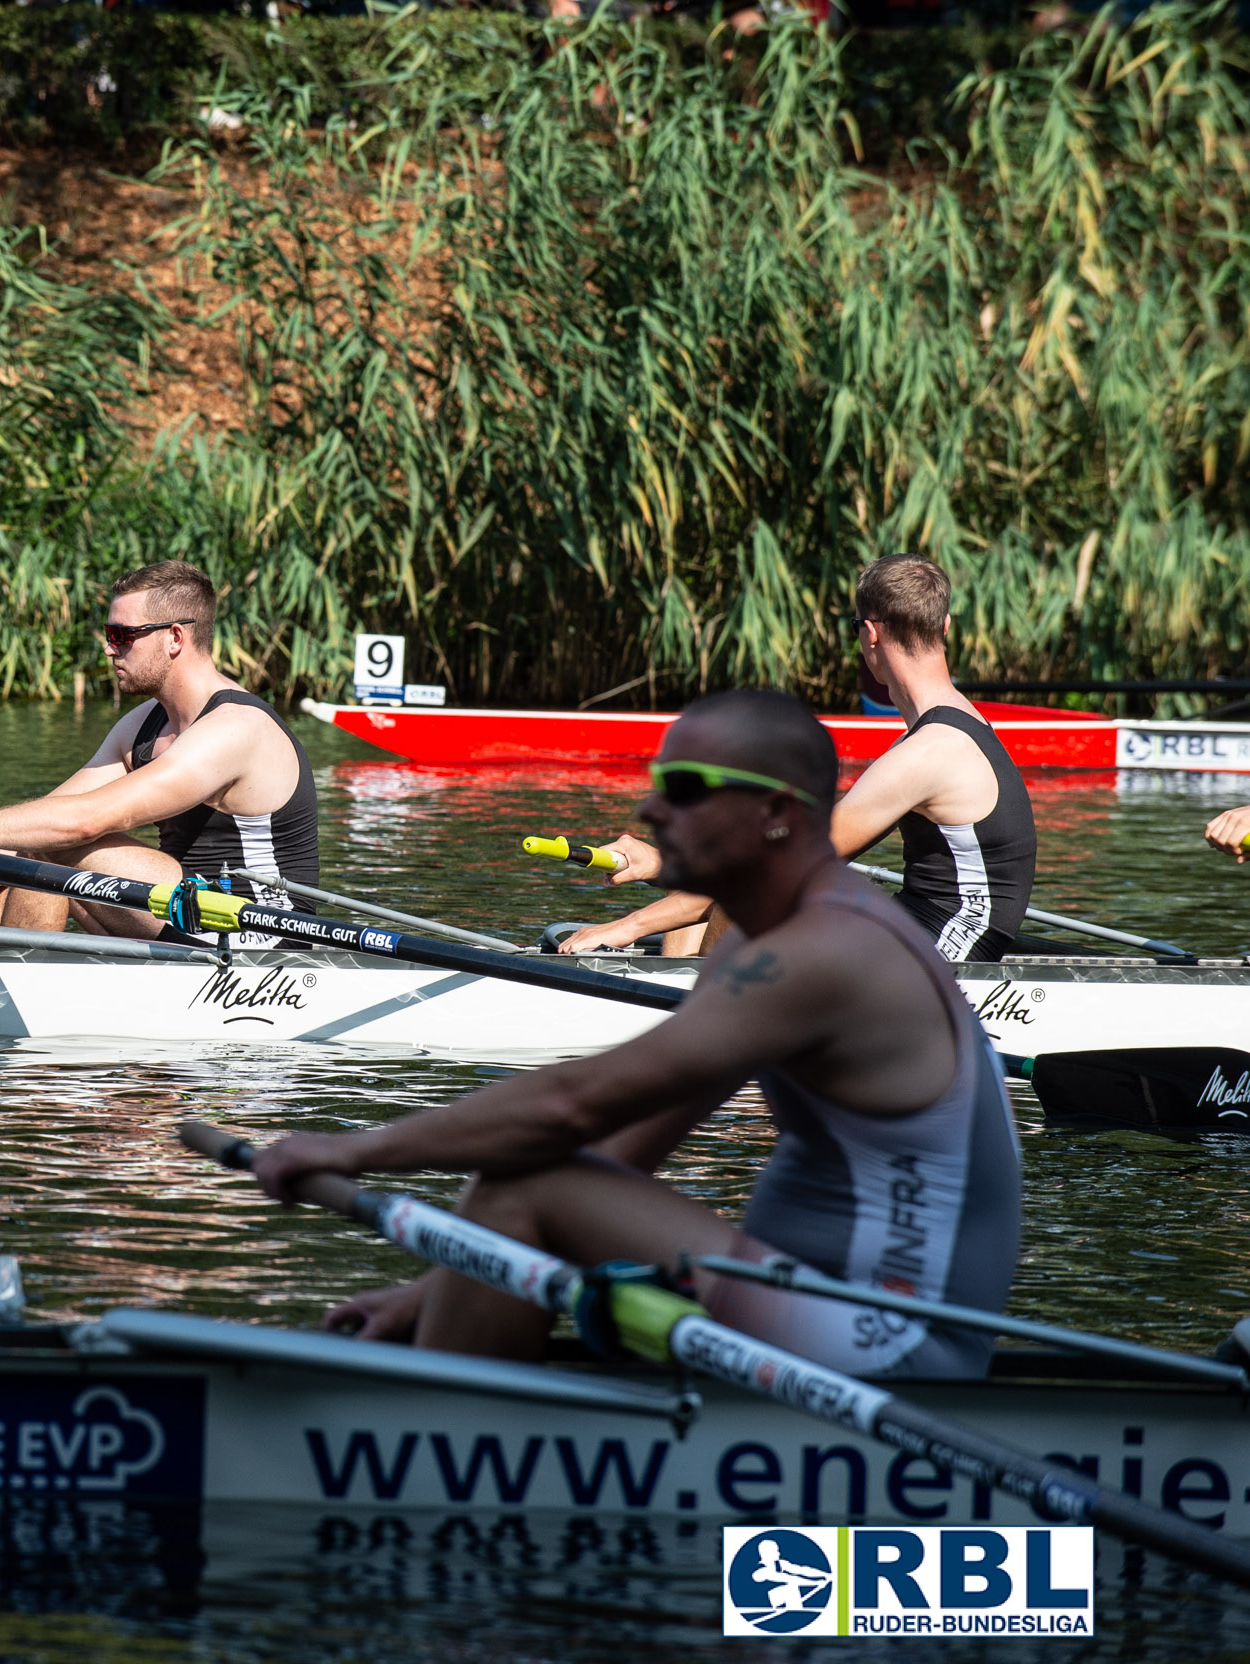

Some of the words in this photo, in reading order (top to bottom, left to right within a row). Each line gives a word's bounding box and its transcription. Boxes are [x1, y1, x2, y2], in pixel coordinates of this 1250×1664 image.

[367, 640, 393, 678] 9
[1161, 734, 1227, 756] RBL
[242, 911, 279, 929] STARK.
[280, 917, 331, 939] SCHNELL.
[331, 928, 357, 944] GUT.
[364, 932, 394, 949] RBL
[17, 1421, 124, 1471] EVP
